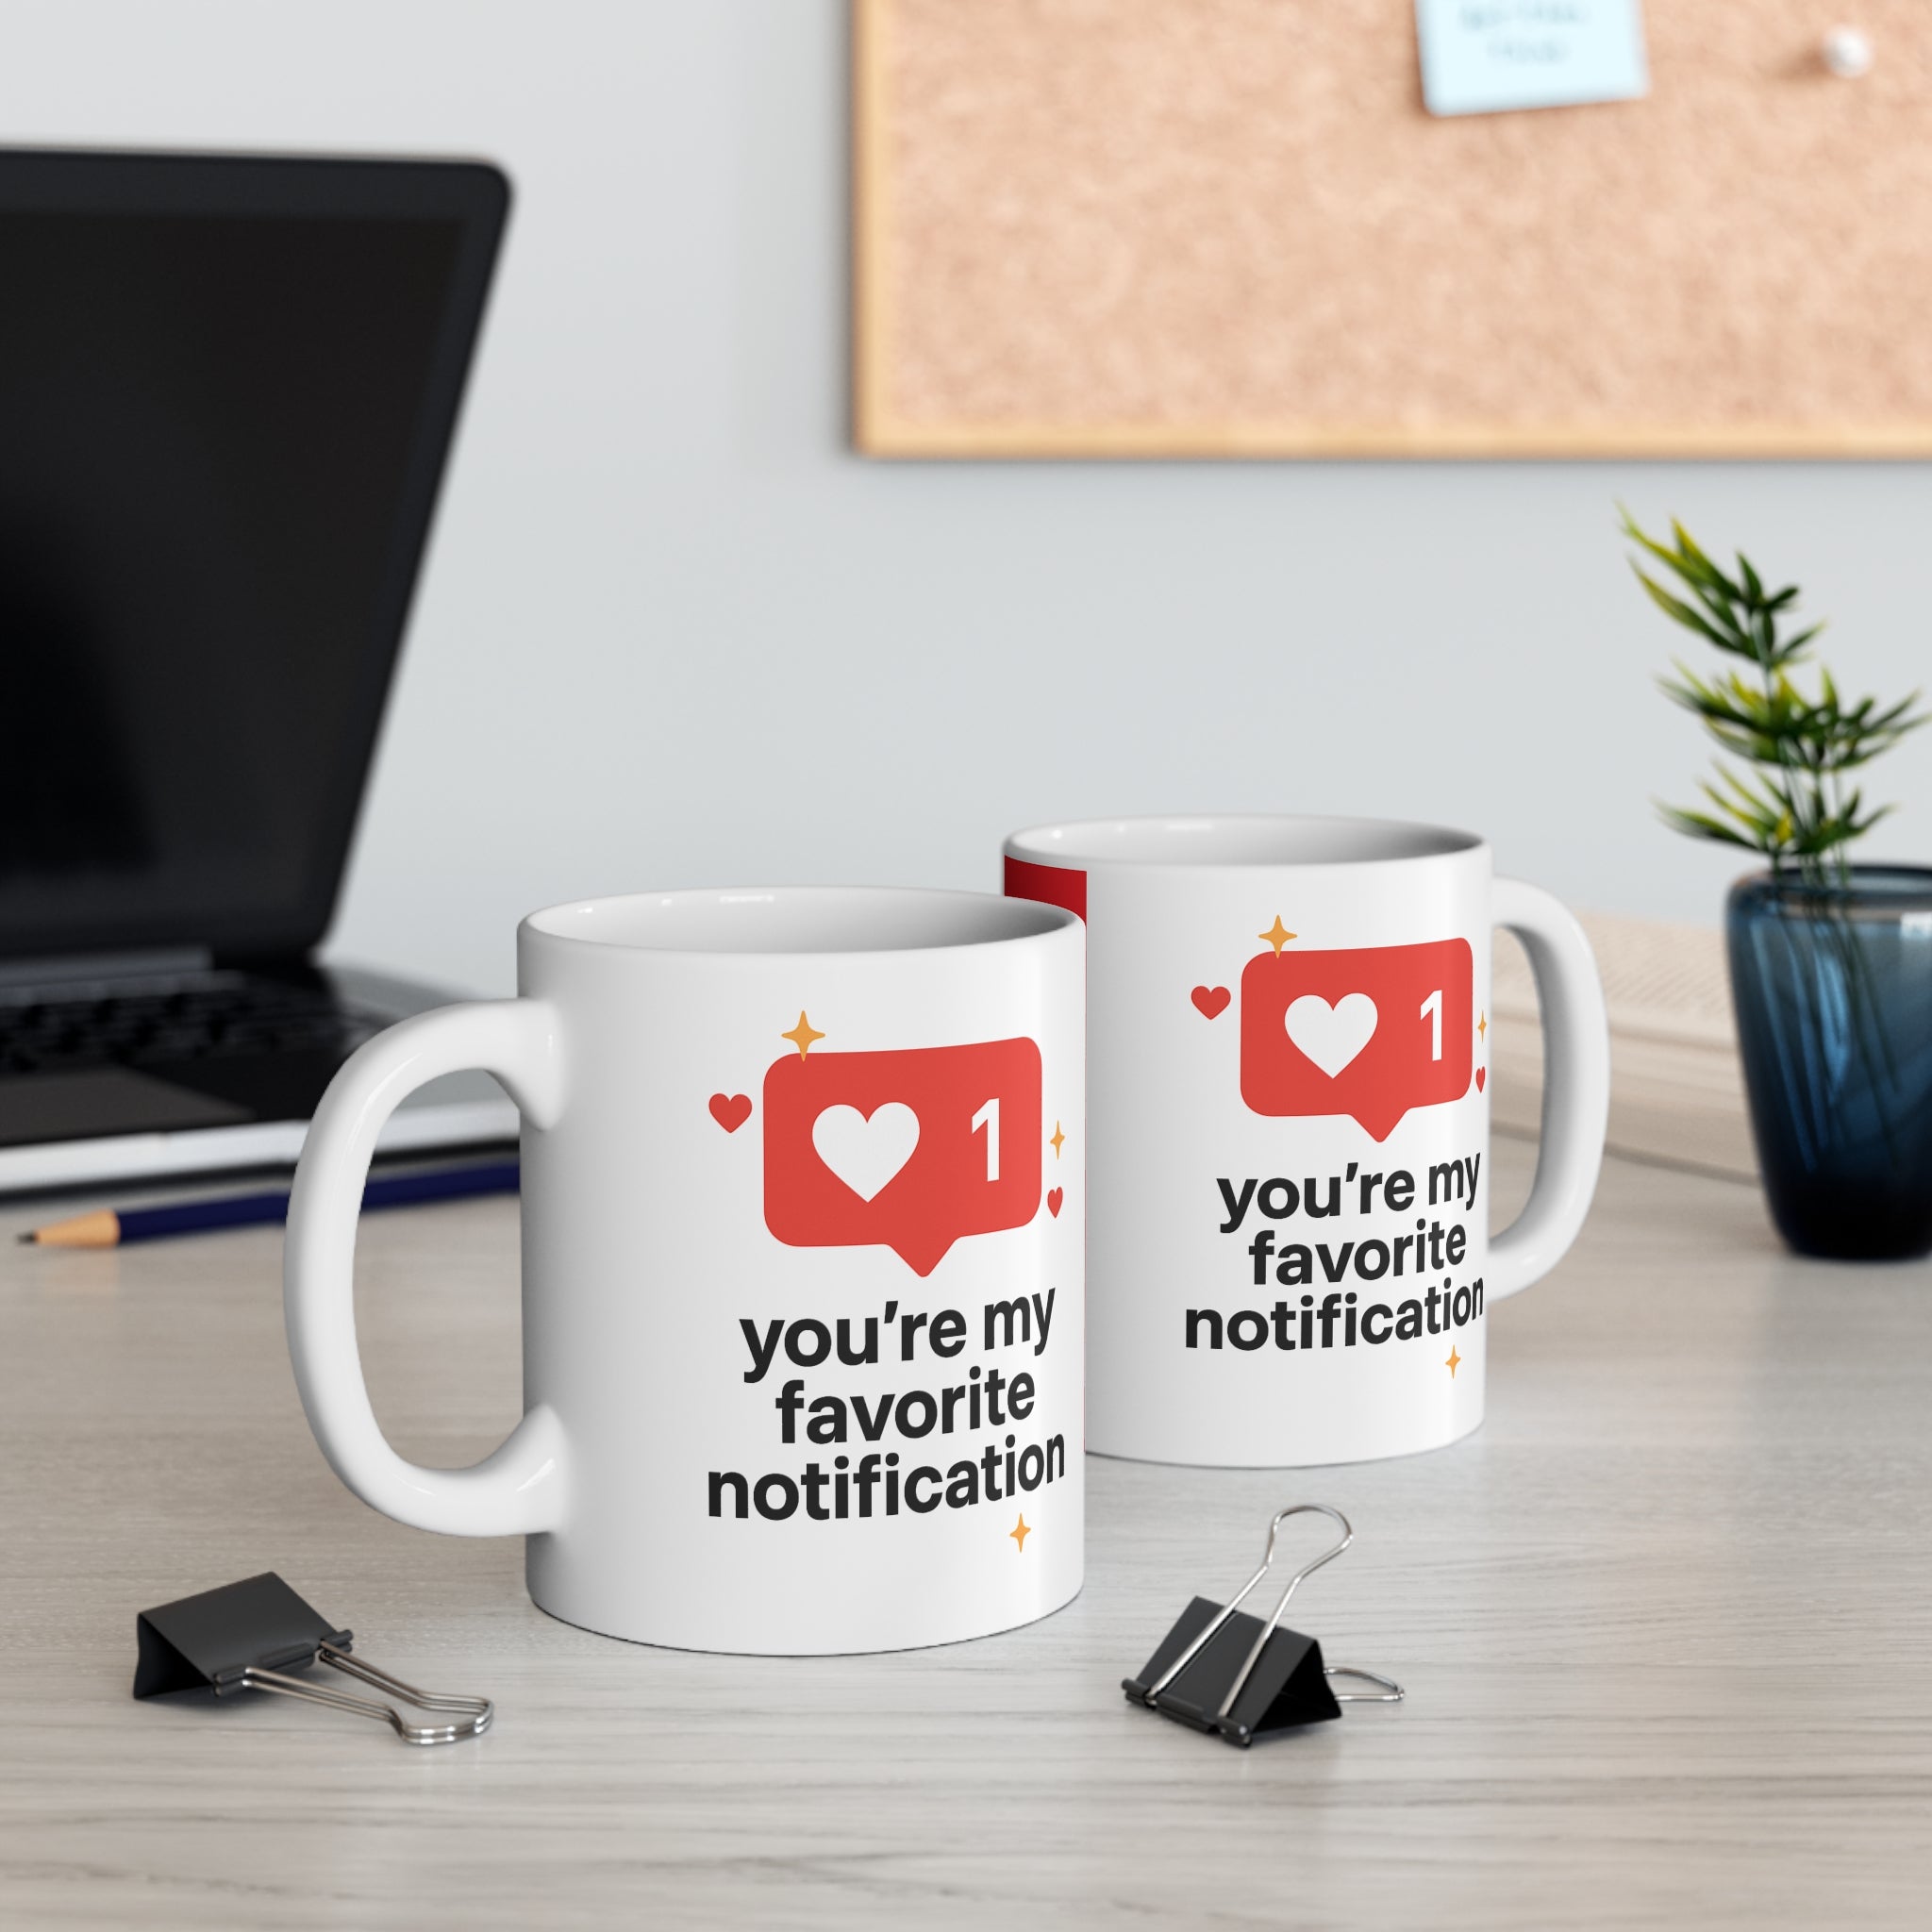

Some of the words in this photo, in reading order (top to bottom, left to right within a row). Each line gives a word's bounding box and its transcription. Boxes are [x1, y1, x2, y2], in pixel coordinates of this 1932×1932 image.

[1420, 990, 1443, 1062] 1
[972, 1097, 1001, 1183] 1
[1216, 1161, 1416, 1234] you're
[1428, 1152, 1482, 1212] my
[1248, 1218, 1467, 1286] favorite
[739, 1300, 968, 1385] you're
[984, 1287, 1057, 1358] my
[1185, 1276, 1485, 1352] notification
[774, 1365, 1036, 1445] favorite
[708, 1433, 1066, 1521] notification
